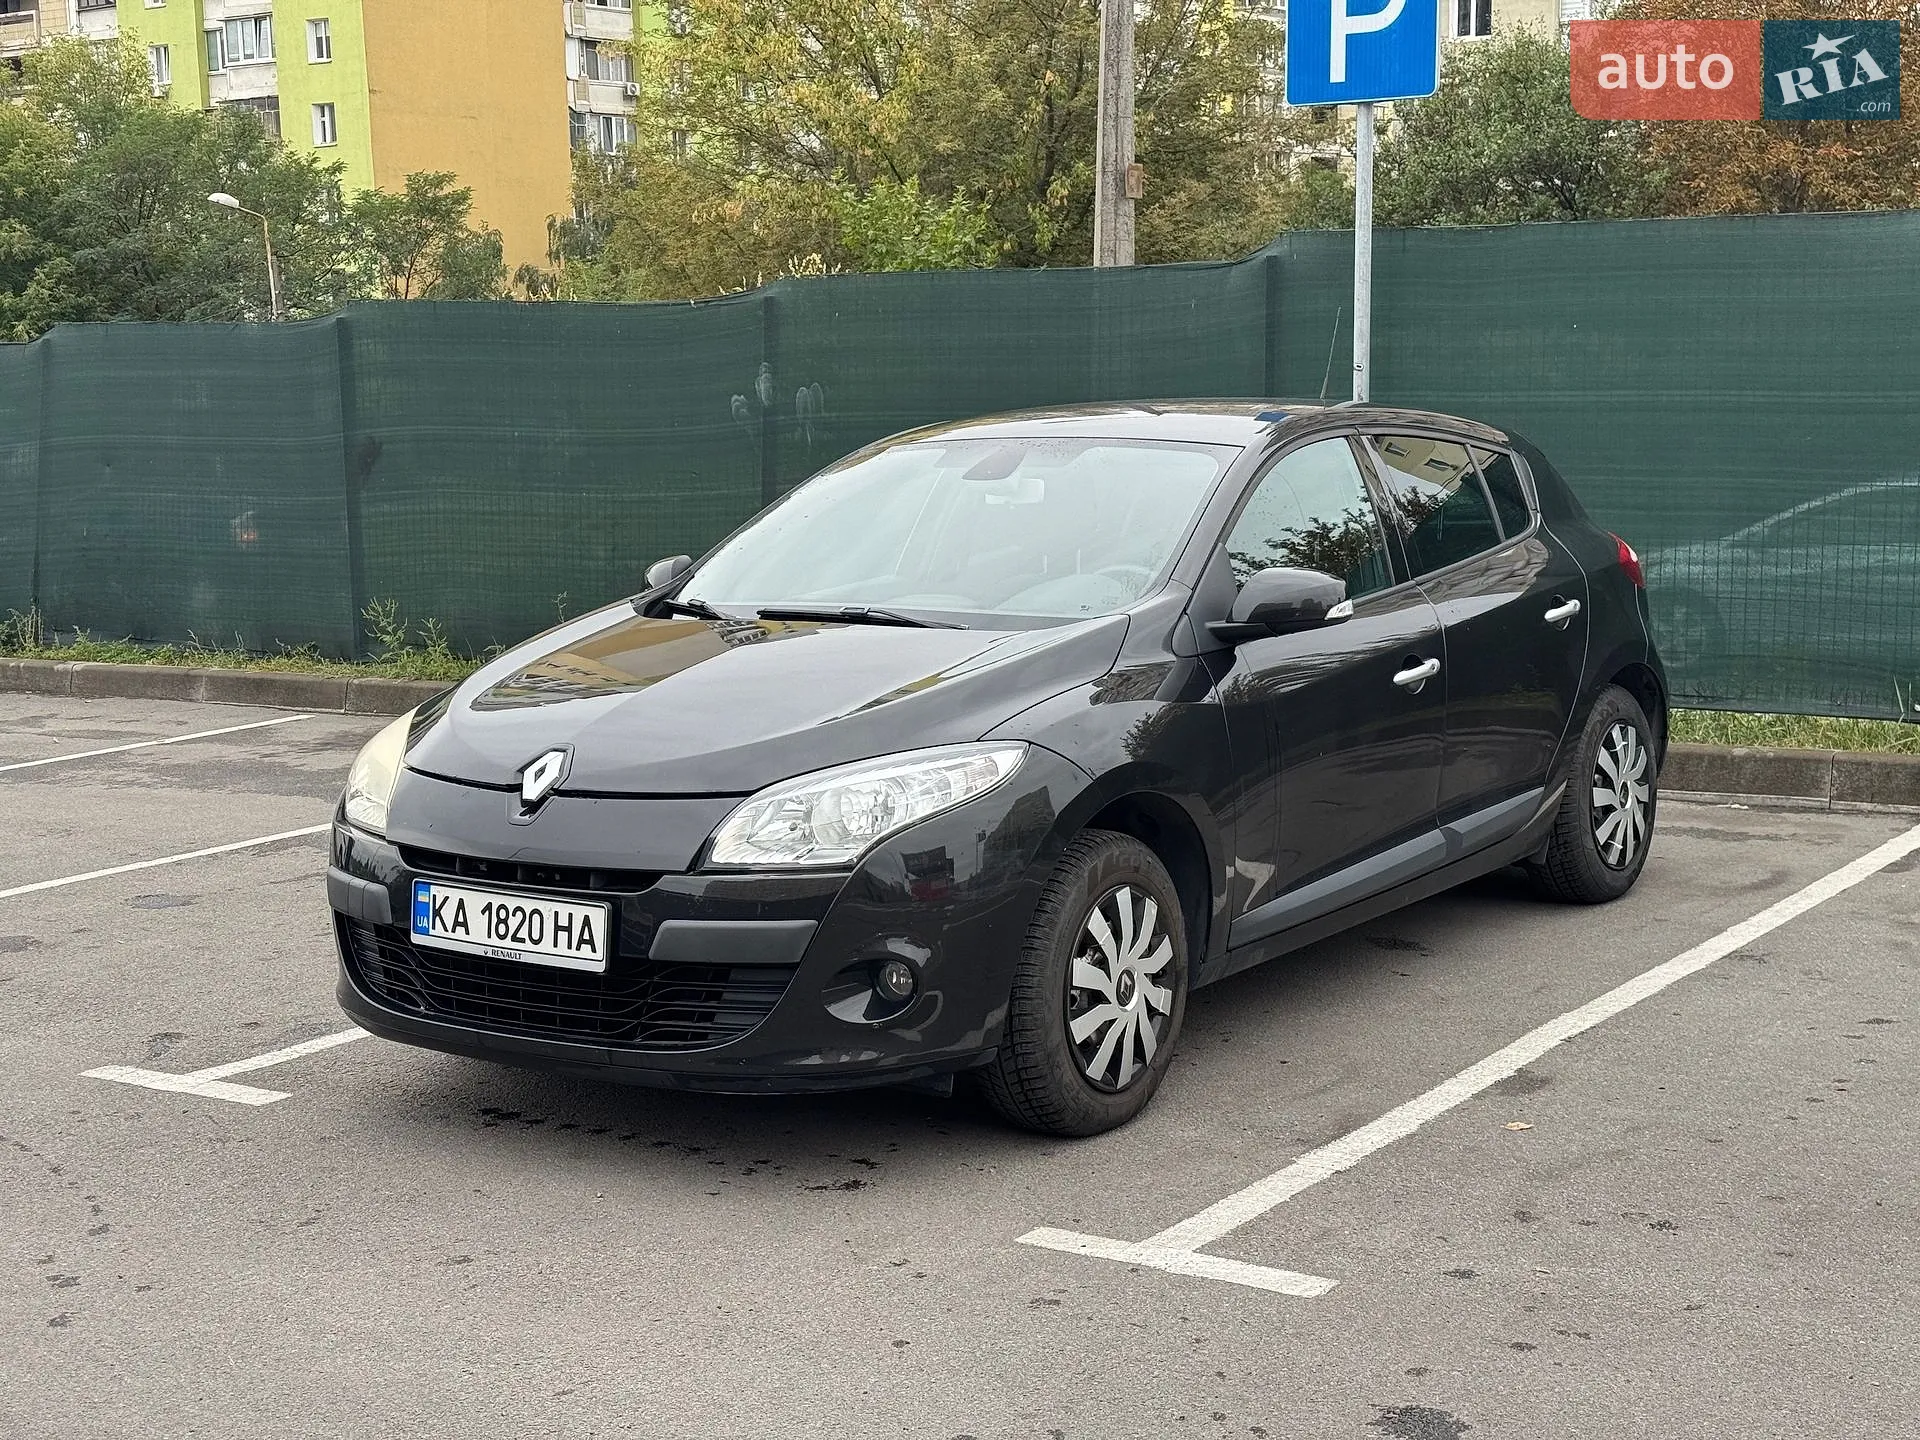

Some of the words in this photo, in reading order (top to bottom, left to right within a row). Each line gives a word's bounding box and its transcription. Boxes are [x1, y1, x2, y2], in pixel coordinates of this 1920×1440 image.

[1329, 0, 1407, 84] P
[417, 915, 429, 929] UA
[431, 893, 470, 936] KA
[481, 901, 544, 946] 1820
[553, 910, 597, 954] HA
[491, 948, 522, 960] RENAULT
